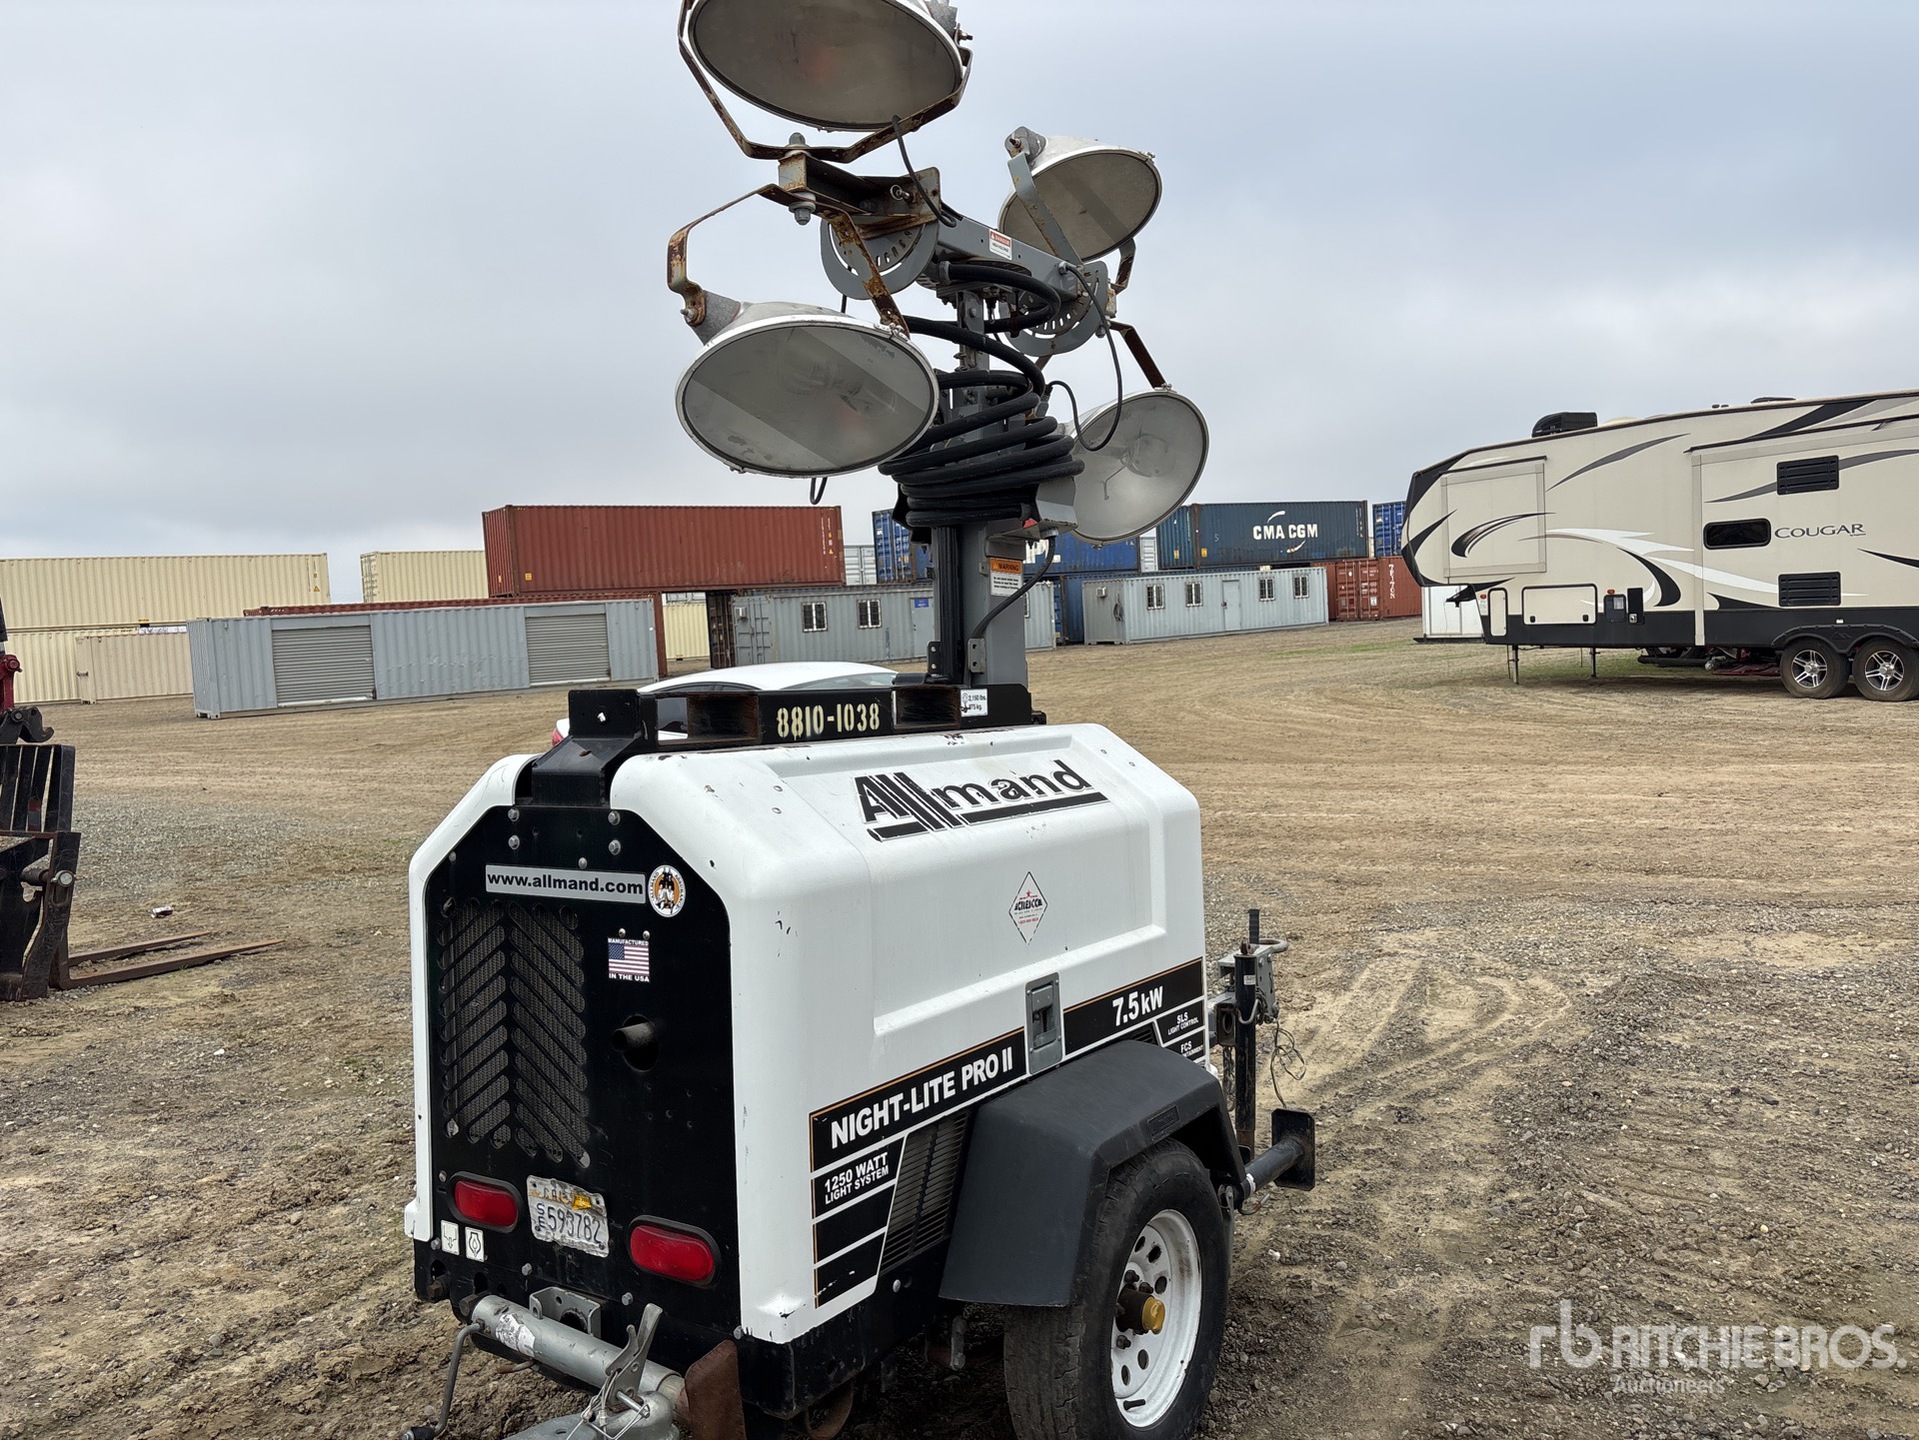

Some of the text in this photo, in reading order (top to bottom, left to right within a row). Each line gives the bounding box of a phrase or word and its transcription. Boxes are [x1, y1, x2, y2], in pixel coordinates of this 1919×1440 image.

[1253, 524, 1318, 540] CMA CGM
[1774, 523, 1865, 539] COUGAR
[998, 563, 1019, 572] WARNING
[777, 703, 880, 739] 8810-1038
[487, 874, 644, 895] www.allmand.com
[608, 938, 649, 946] MANUFACTURED
[618, 973, 633, 981] THE
[1167, 1016, 1199, 1036] LIGHT CONTROL
[1176, 1011, 1189, 1025] SLS
[1180, 1040, 1193, 1054] FCS
[831, 1046, 1013, 1149] NIGHT-LITE PRO II
[824, 1151, 888, 1193] 1250 WATT
[825, 1165, 889, 1205] LIGHT SYSTEM
[547, 1205, 602, 1244] 593782
